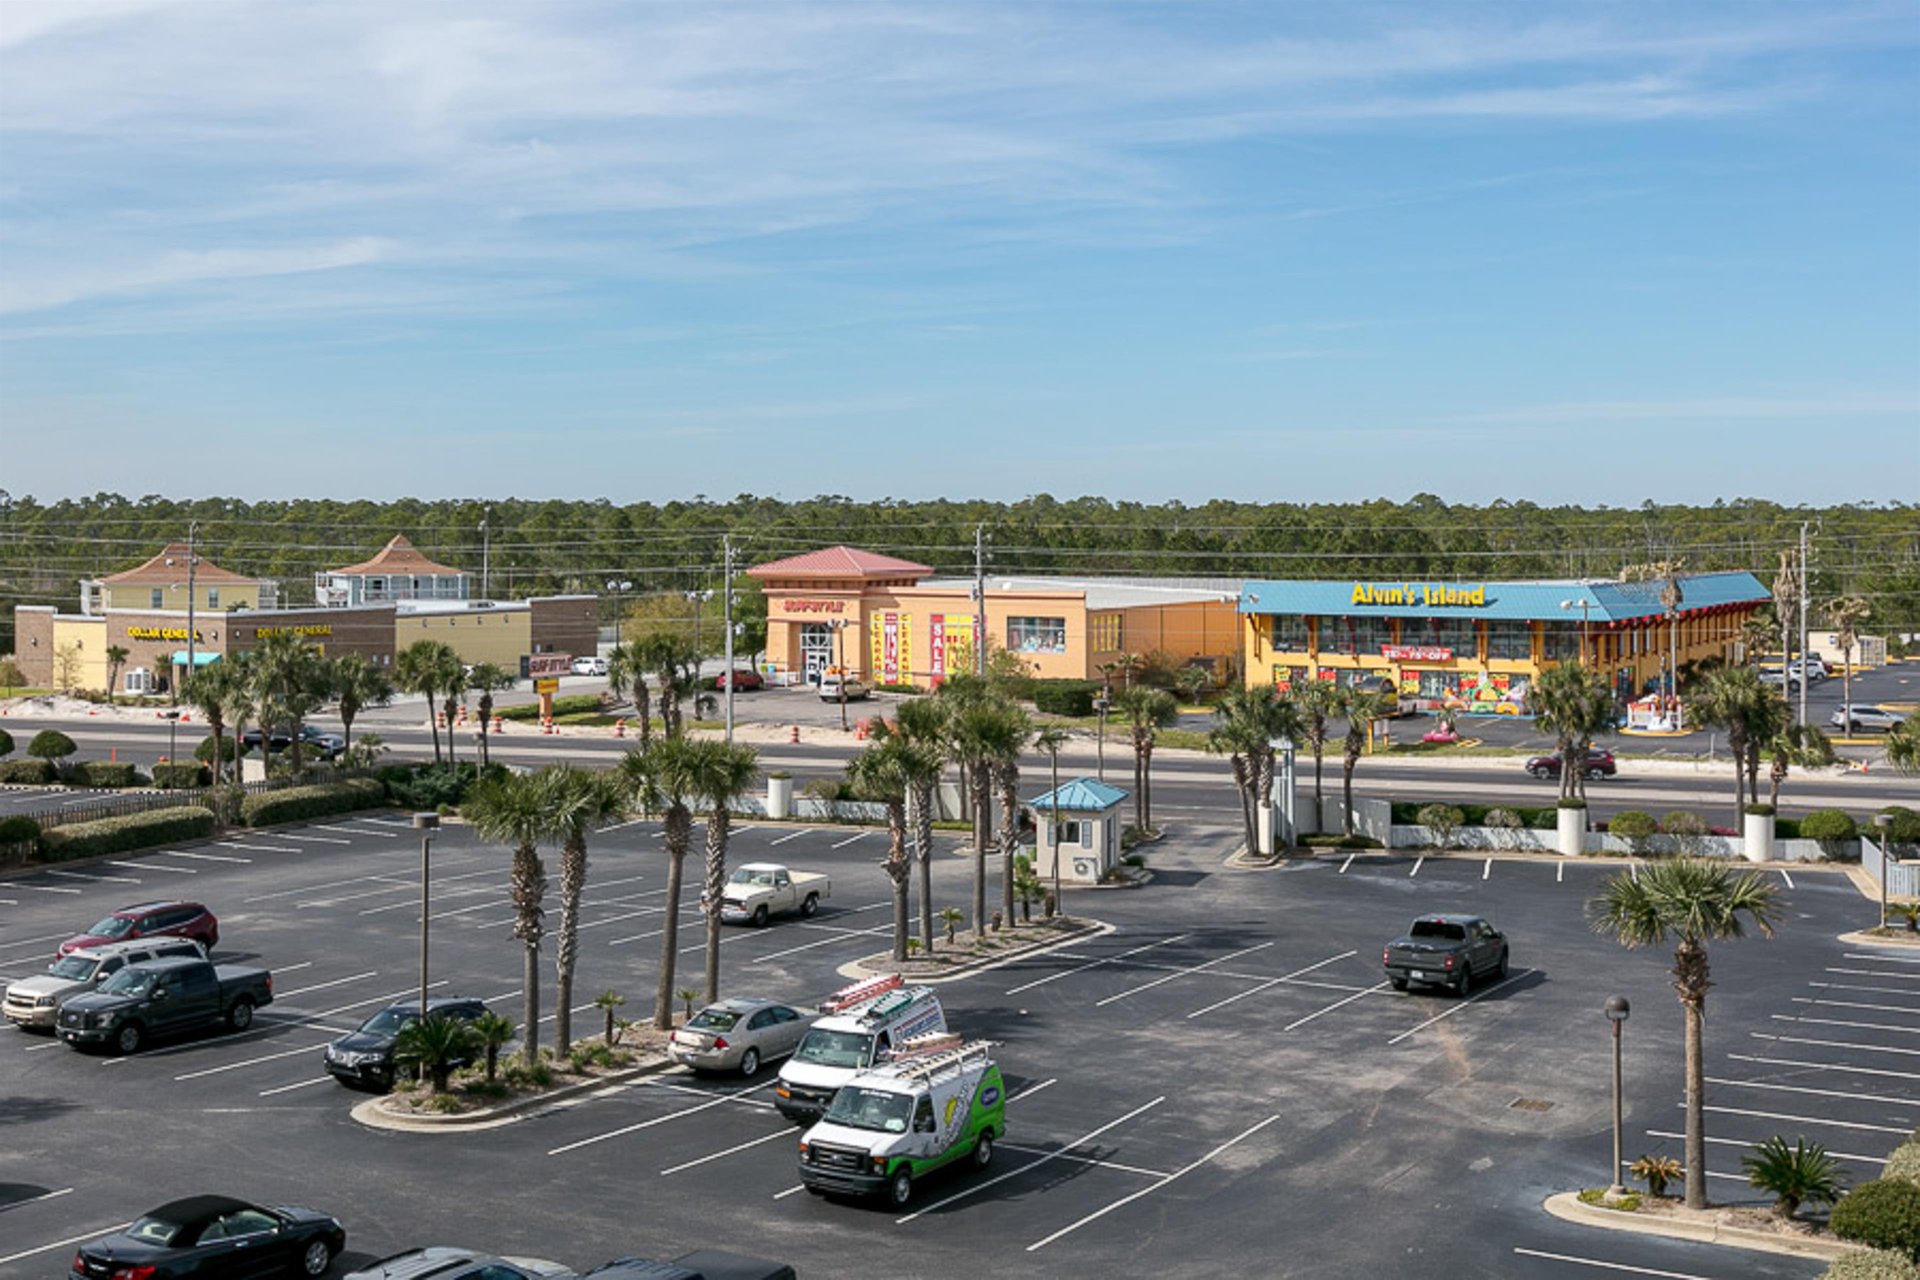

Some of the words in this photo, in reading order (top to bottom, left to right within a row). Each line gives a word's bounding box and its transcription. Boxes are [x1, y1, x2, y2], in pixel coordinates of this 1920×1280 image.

[1352, 583, 1415, 604] Alvin's
[1423, 585, 1485, 605] Island
[128, 627, 159, 638] DOLLAR
[933, 624, 943, 673] SALE
